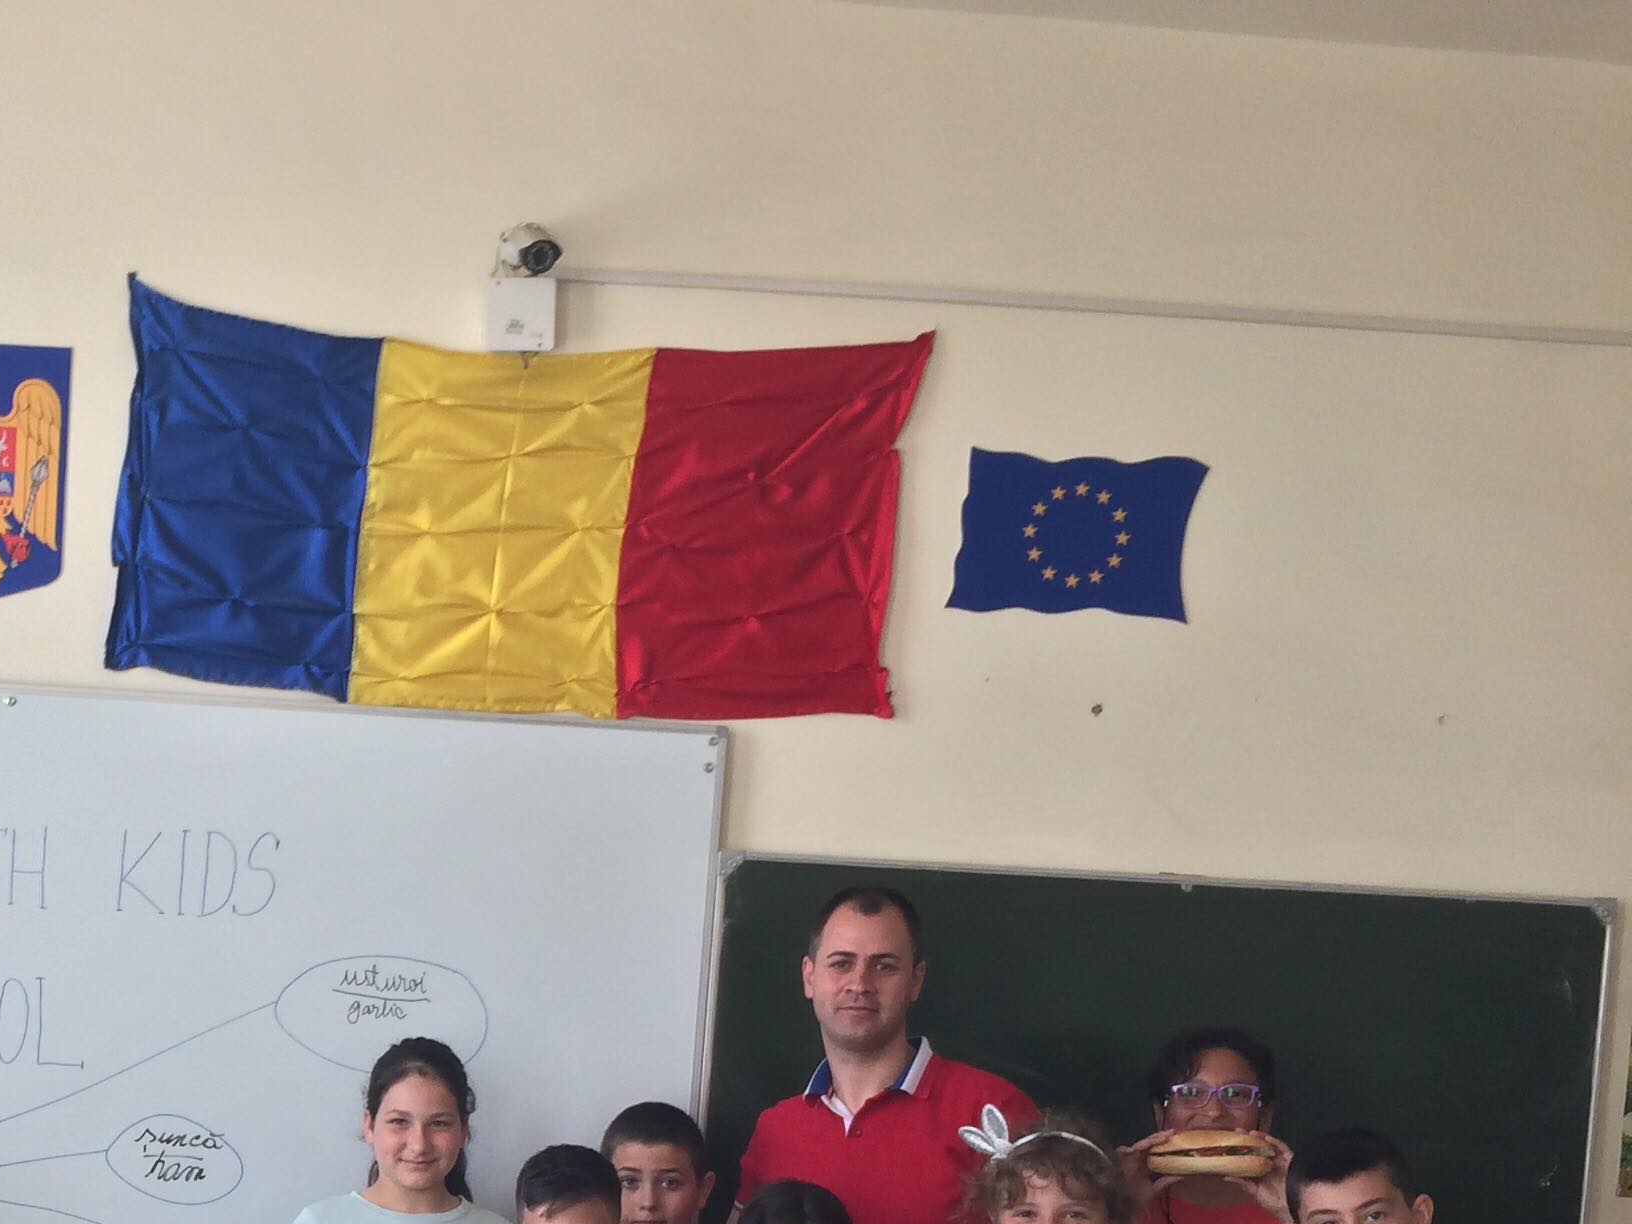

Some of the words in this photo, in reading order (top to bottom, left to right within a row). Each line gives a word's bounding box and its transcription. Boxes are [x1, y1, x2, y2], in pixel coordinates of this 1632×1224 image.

[115, 828, 281, 918] KIDS
[339, 963, 428, 995] usturoi
[346, 1000, 409, 1025] garlic
[144, 1150, 207, 1182] ham
